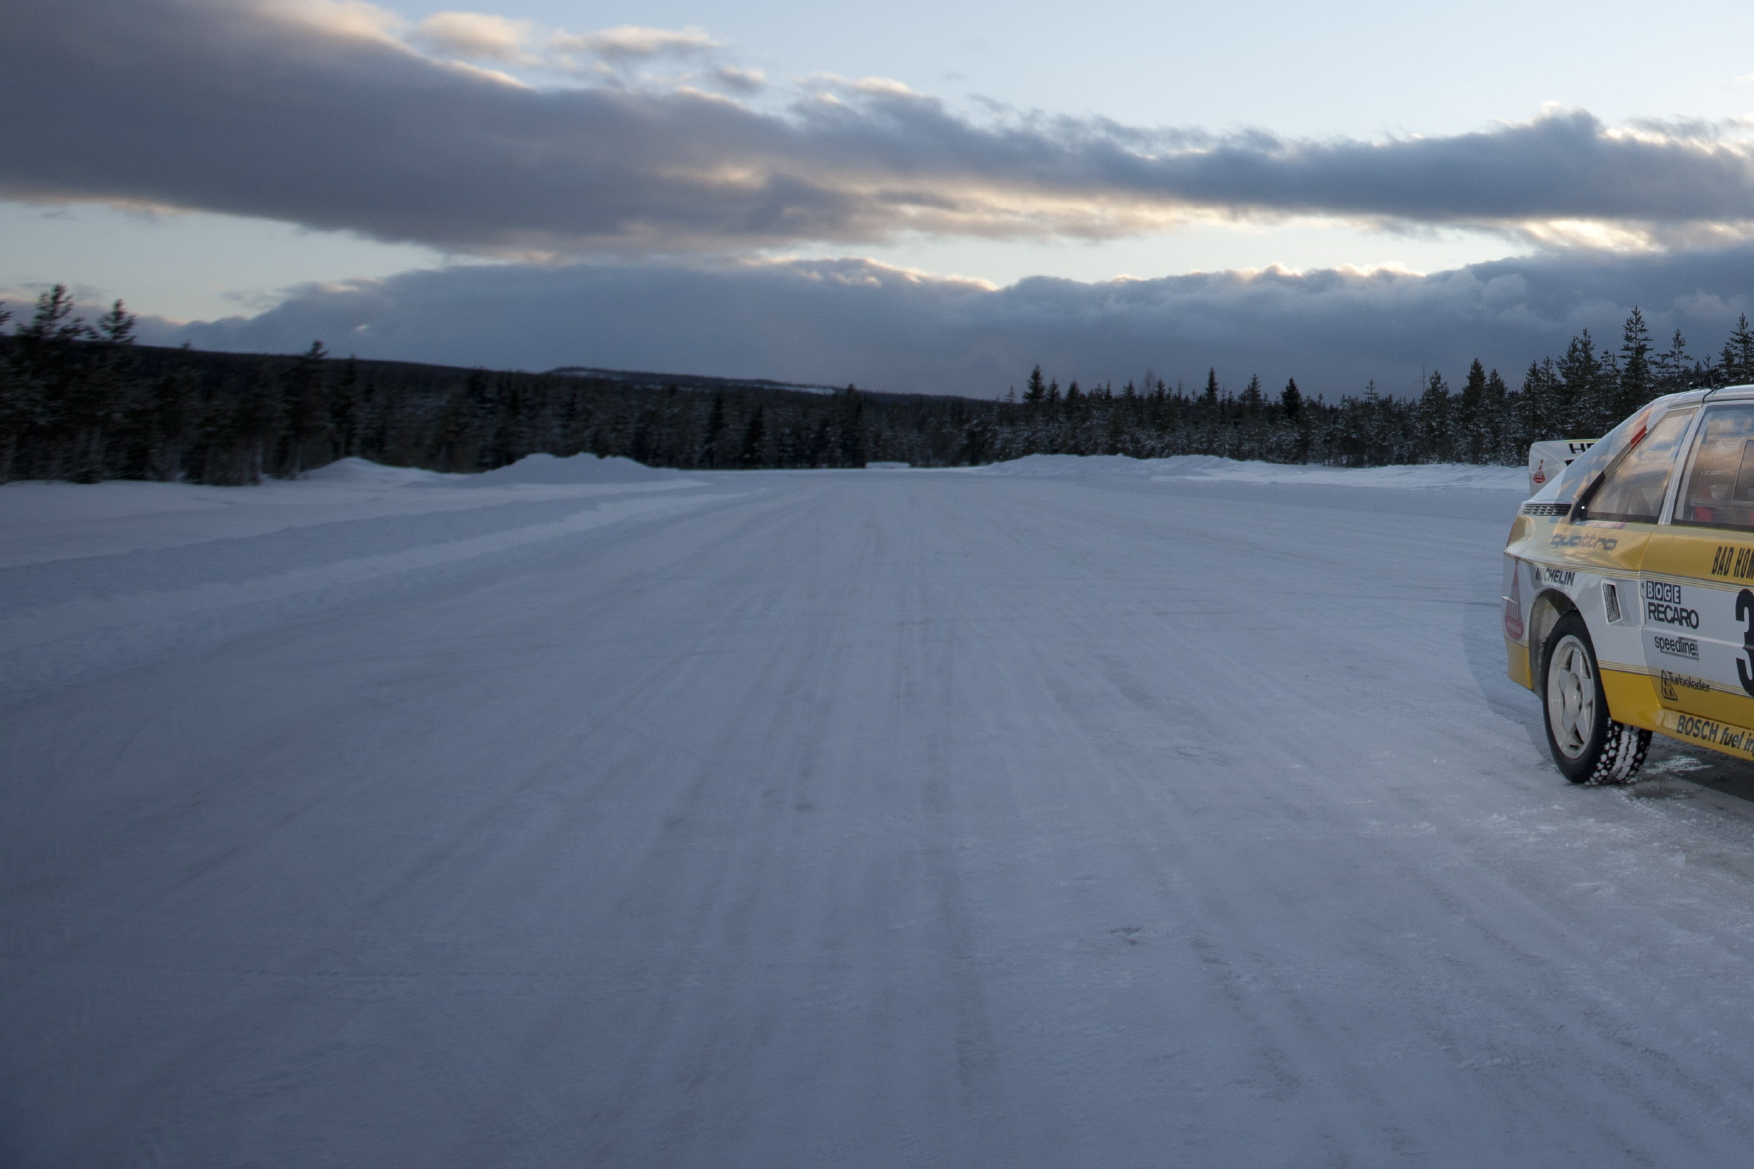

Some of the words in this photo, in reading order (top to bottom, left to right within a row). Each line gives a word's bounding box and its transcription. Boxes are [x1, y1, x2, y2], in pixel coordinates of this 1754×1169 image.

[1550, 533, 1619, 552] quattro
[1711, 545, 1735, 575] BAD
[1535, 566, 1576, 587] MICHELIN
[1647, 580, 1681, 605] BOGE
[1647, 601, 1700, 630] RECARO
[1654, 635, 1697, 658] speedline
[1666, 670, 1711, 693] Turbolader
[1676, 714, 1720, 743] BOSCH
[1719, 726, 1745, 750] fuel
